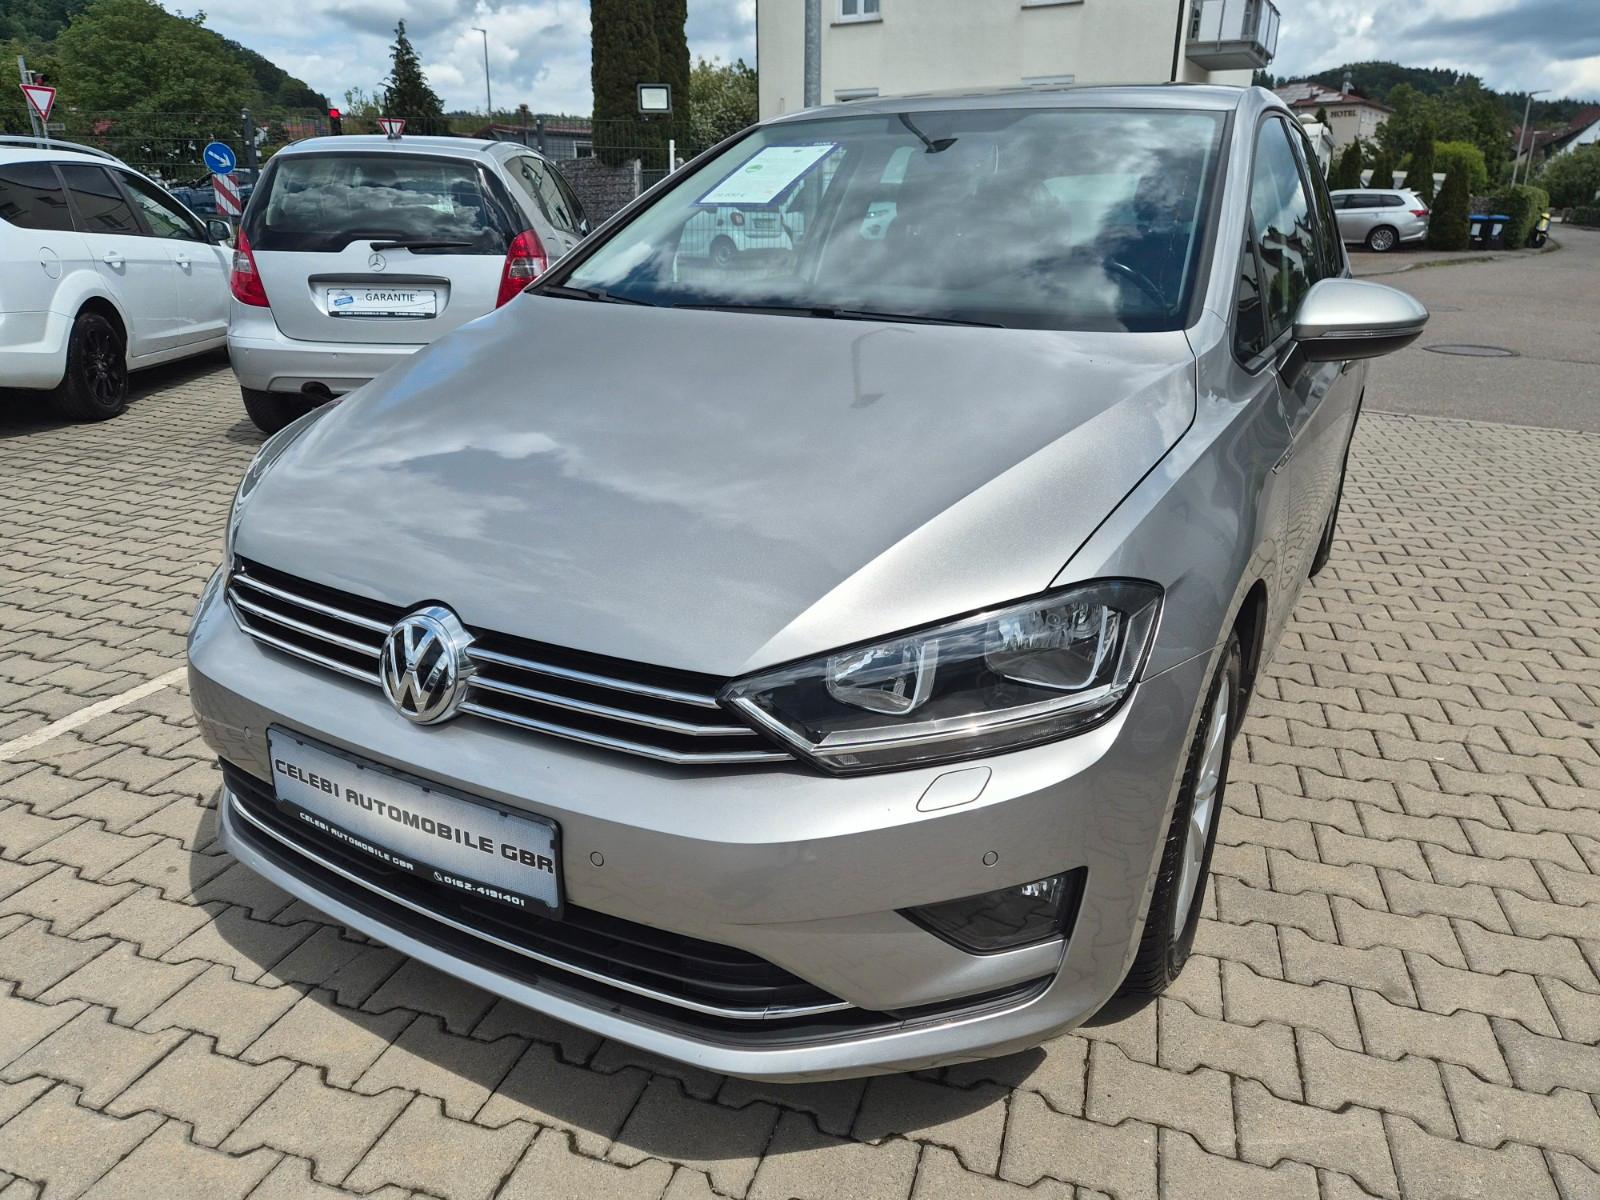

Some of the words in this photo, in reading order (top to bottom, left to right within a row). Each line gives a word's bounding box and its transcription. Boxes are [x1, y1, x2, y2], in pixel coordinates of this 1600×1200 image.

[1330, 110, 1356, 118] HOTEL
[365, 292, 416, 302] GARANTIE
[274, 758, 340, 798] CELEBI
[345, 787, 494, 855] AUTOMOBILE
[500, 842, 554, 874] GBR
[299, 811, 330, 832] CELEBI
[331, 828, 390, 861] AUTOMOBILE
[392, 856, 415, 871] GBR
